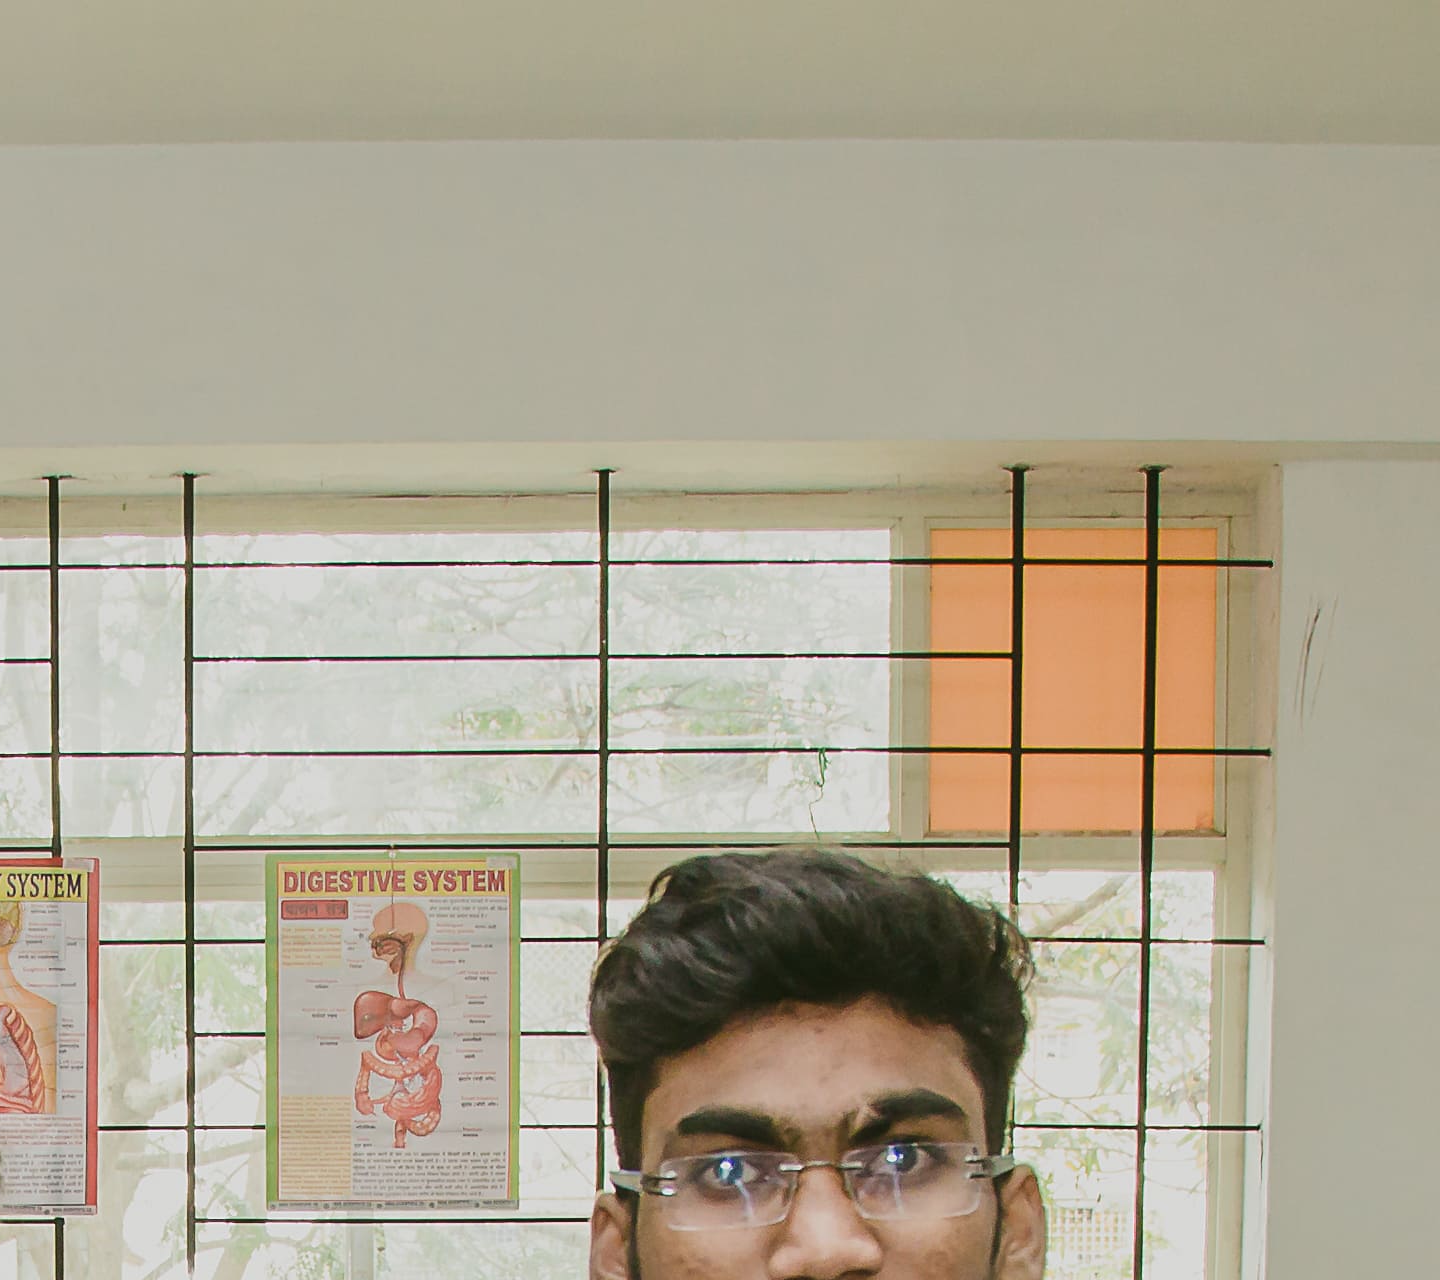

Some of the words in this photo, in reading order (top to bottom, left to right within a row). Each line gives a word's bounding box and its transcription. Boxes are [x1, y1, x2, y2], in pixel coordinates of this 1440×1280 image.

[7, 873, 83, 898] SYSTEM
[284, 870, 406, 893] DIGESTIVE
[413, 870, 506, 893] SYSTEM
